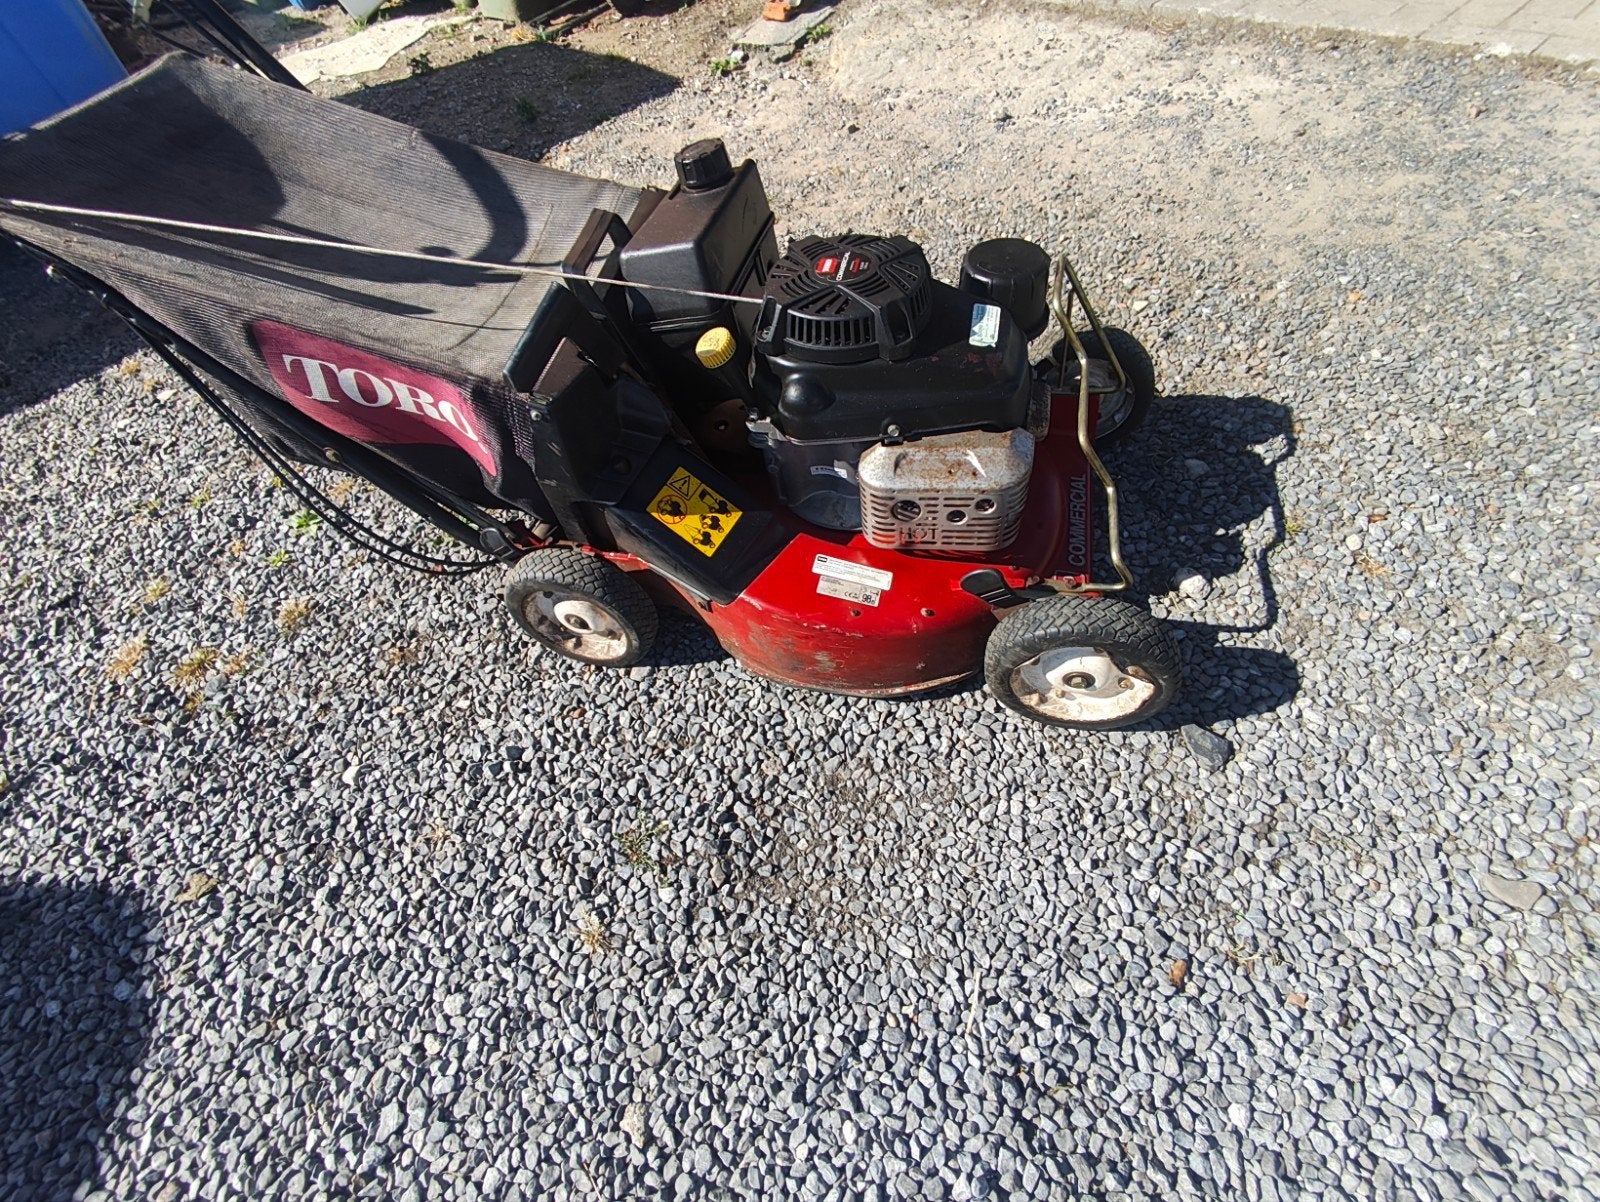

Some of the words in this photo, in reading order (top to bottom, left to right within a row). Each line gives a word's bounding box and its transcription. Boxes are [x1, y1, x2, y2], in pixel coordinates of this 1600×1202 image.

[282, 354, 478, 441] TORO
[900, 527, 938, 541] HOT
[1068, 474, 1086, 567] COMMERCIAL
